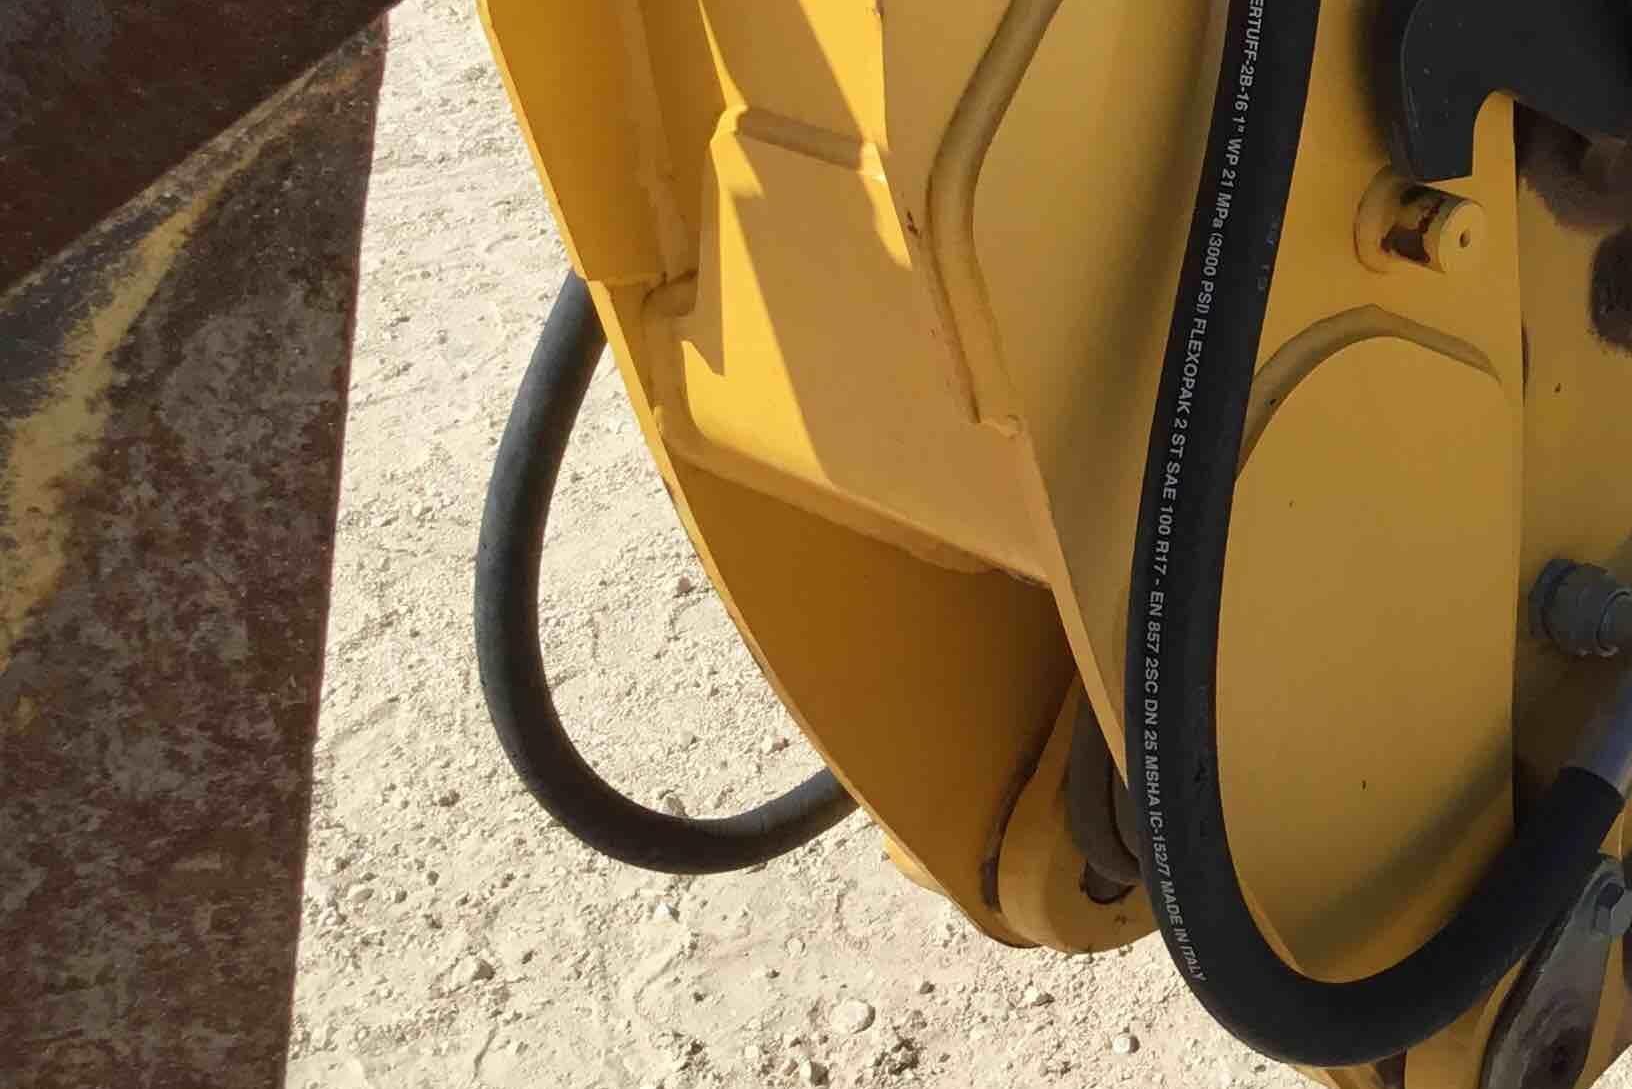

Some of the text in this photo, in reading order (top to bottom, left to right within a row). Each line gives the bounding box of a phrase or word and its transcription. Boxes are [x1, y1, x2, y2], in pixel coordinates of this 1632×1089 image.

[1225, 138, 1242, 166] WP
[1220, 169, 1236, 188] 21
[1212, 193, 1231, 229] MPa
[1202, 233, 1224, 276] (3000
[1176, 318, 1207, 413] FLEXOPAK
[1174, 418, 1187, 429] 2
[1169, 433, 1186, 459] ST
[1162, 461, 1181, 500] SAE
[1158, 505, 1174, 535] 100
[1153, 539, 1170, 575] R17
[1148, 591, 1164, 617] EN
[1146, 621, 1160, 653] 857
[1144, 656, 1159, 695] 2SC
[1144, 699, 1158, 725] DN
[1144, 729, 1157, 751] 25
[1144, 755, 1161, 807] MSHA
[1149, 811, 1171, 876] IC-152/7
[1160, 880, 1183, 926] MADE
[1173, 928, 1189, 943] IN
[1179, 945, 1206, 983] ITALY
